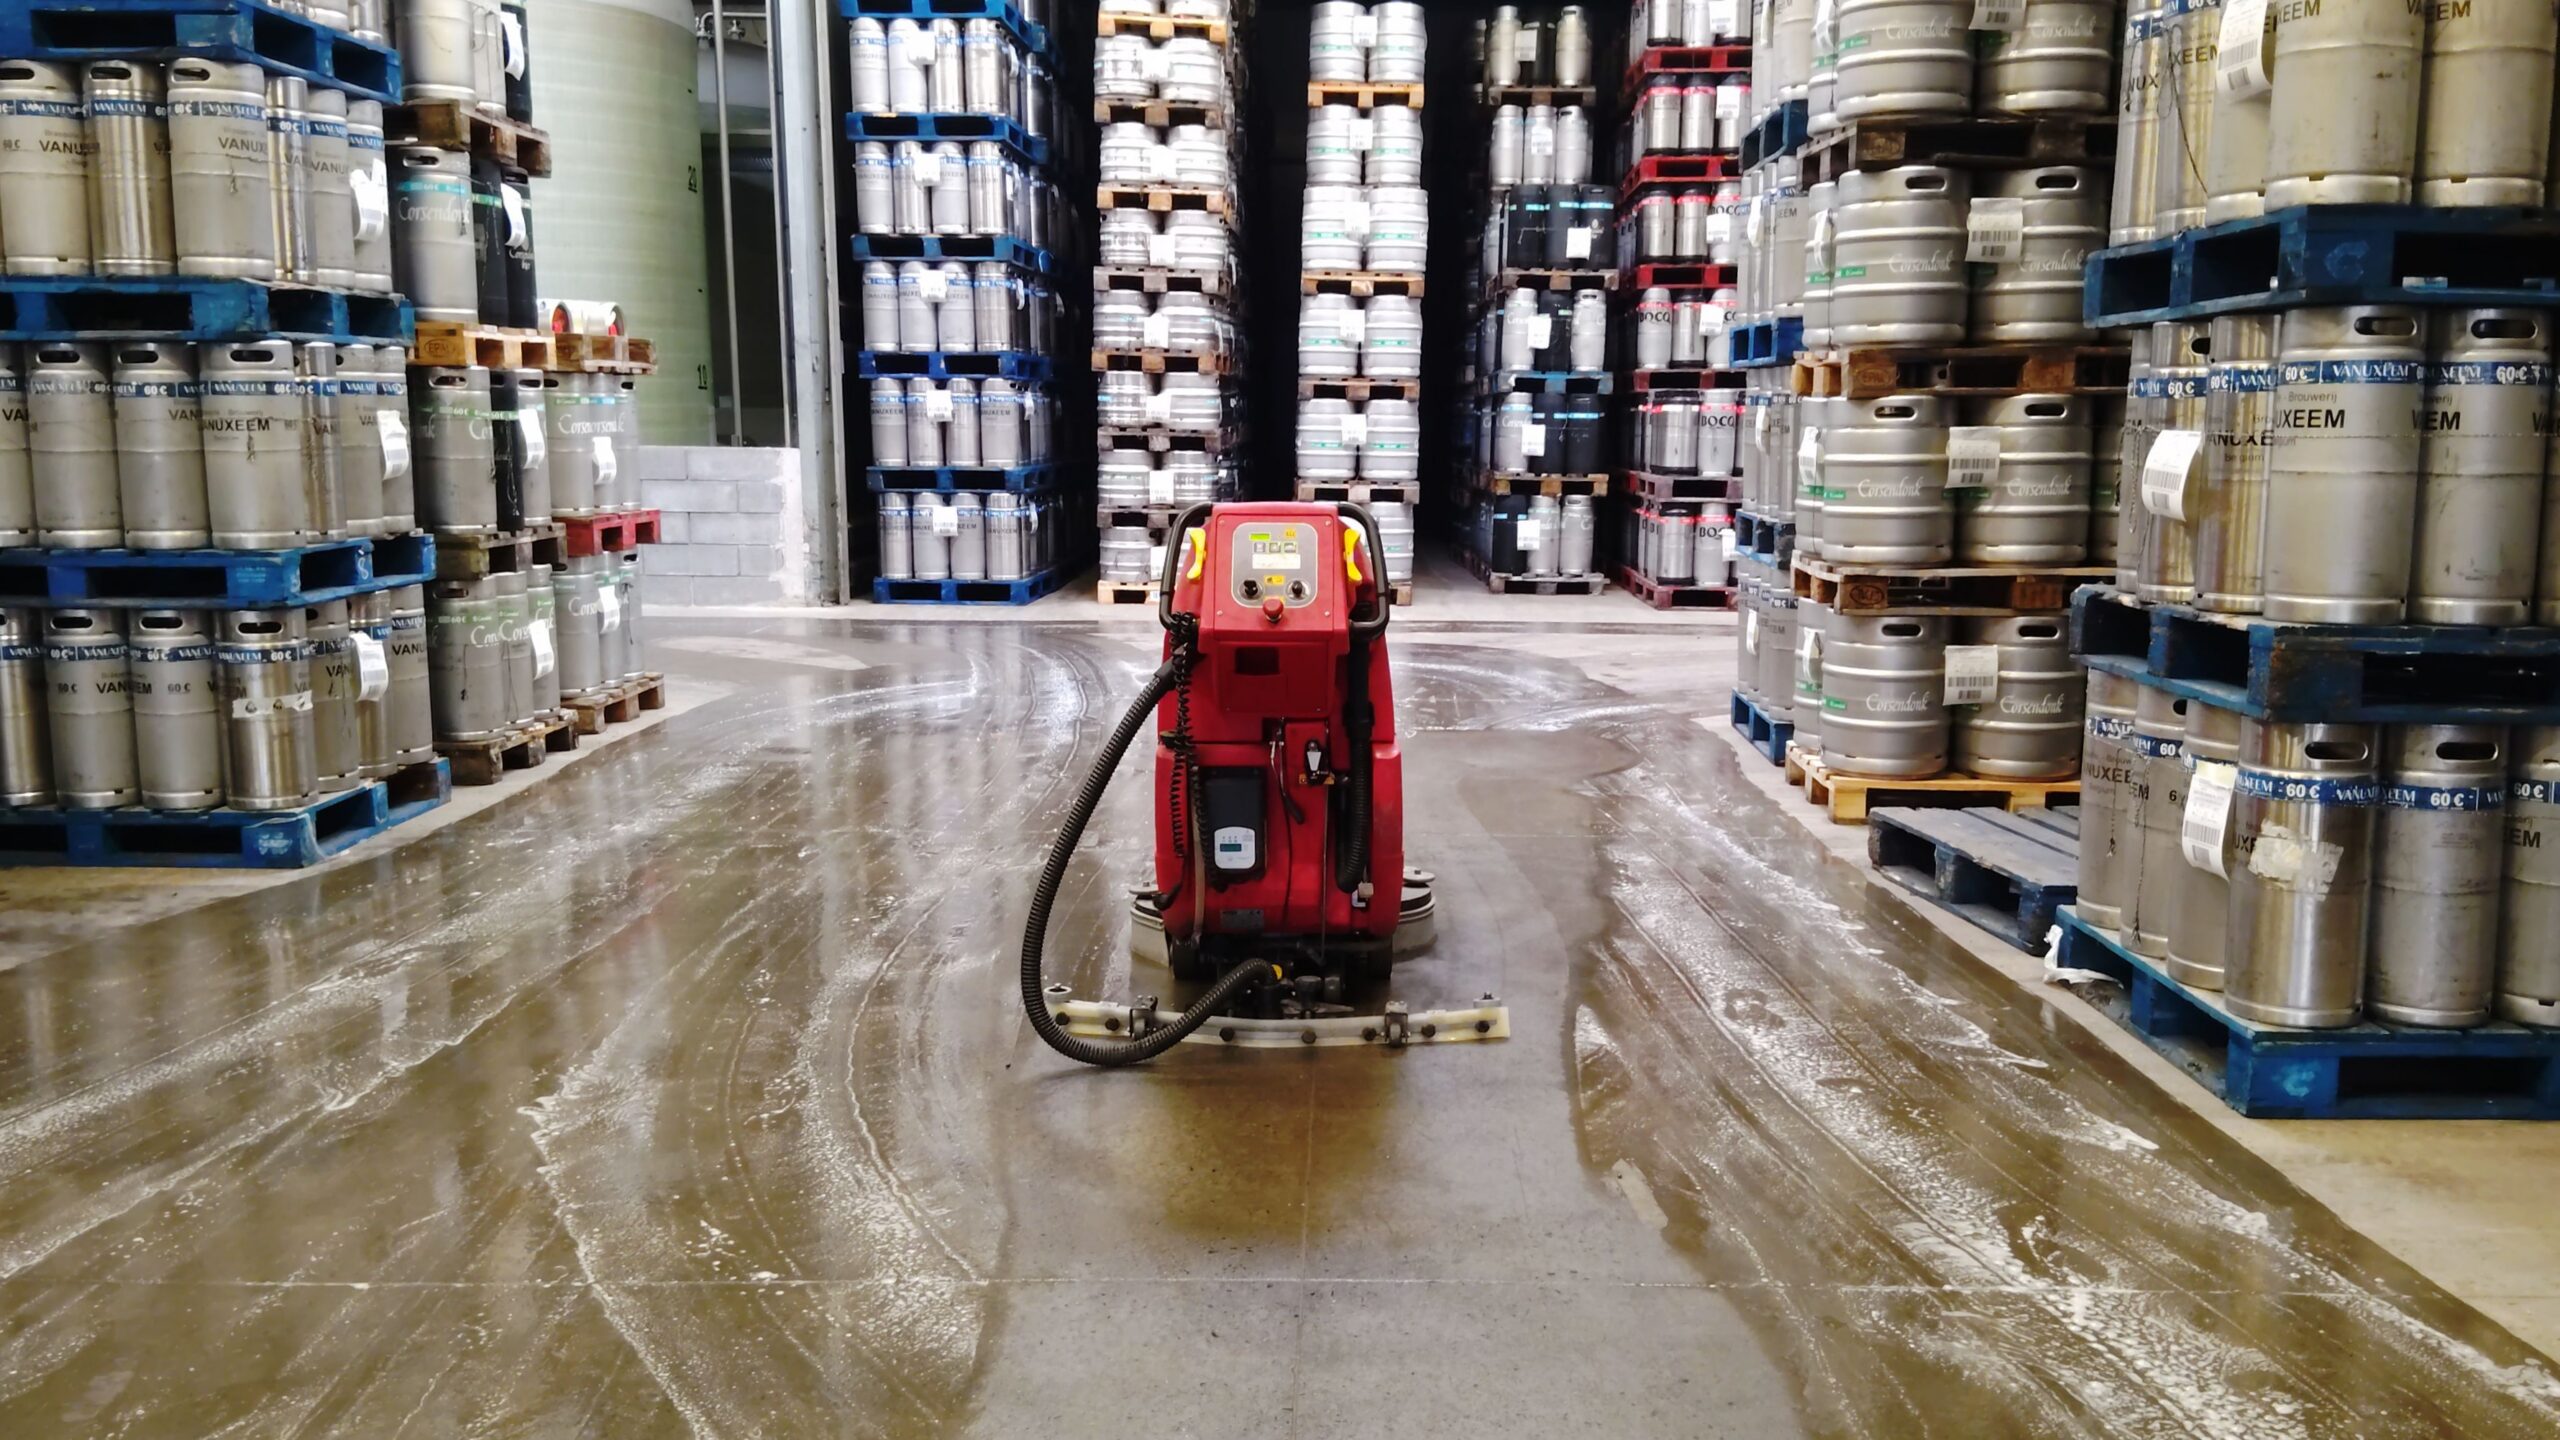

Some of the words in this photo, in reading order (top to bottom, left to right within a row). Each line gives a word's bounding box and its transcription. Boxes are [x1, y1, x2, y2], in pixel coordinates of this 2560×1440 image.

[2285, 367, 2297, 381] 60
[2211, 375, 2221, 389] 60
[2288, 391, 2338, 403] Brouwerij
[2276, 409, 2345, 428] UXEEM
[1858, 476, 1925, 498] Corsendonk
[271, 651, 283, 662] 60
[168, 683, 181, 694] 60
[1866, 690, 1931, 712] Corsendonk
[1999, 692, 2065, 714] Corsendonk
[2160, 743, 2176, 756] 60
[2286, 783, 2306, 798] 60
[2309, 784, 2321, 799] €
[2514, 783, 2531, 797] 60
[2533, 784, 2545, 798] €
[2430, 792, 2450, 806] 60
[2453, 793, 2464, 806] €
